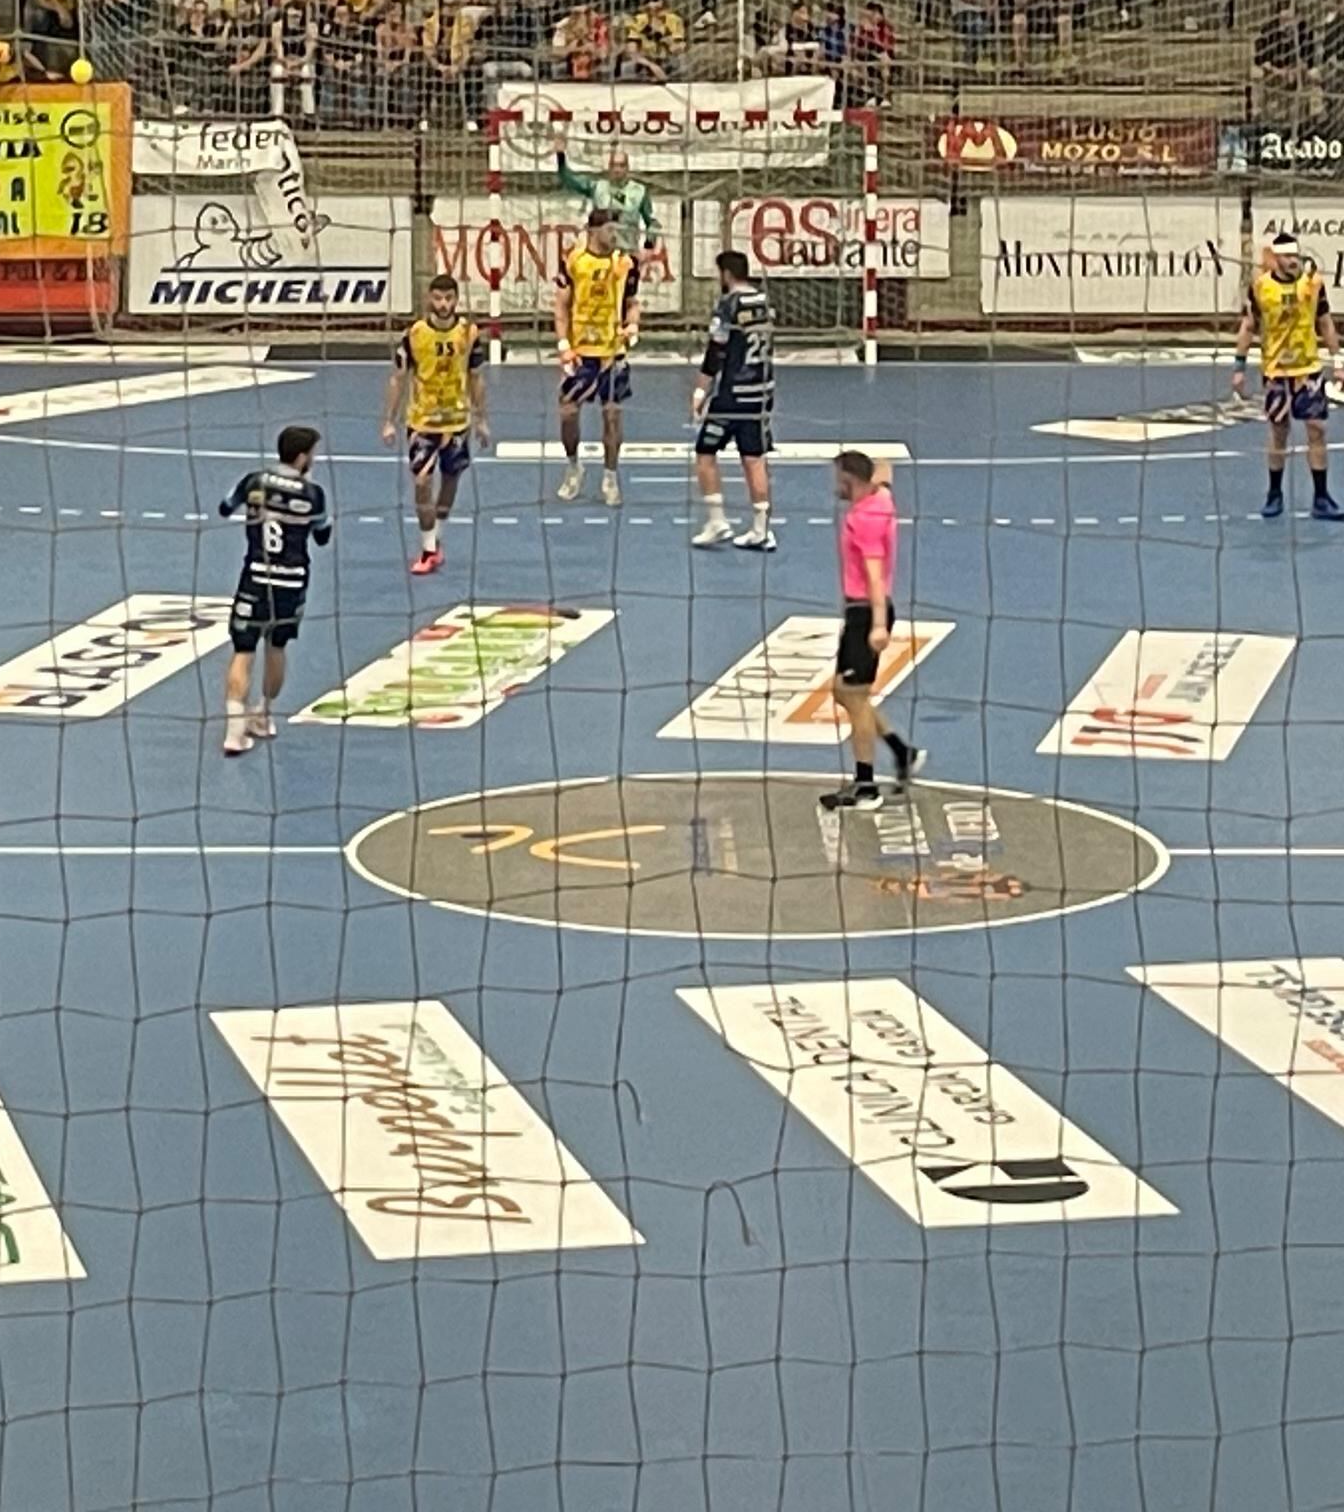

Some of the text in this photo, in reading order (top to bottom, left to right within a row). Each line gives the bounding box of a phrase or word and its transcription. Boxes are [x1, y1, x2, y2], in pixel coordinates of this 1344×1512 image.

[148, 278, 387, 306] MICHELIN
[754, 996, 955, 1150] CLÍNICA DENTAL
